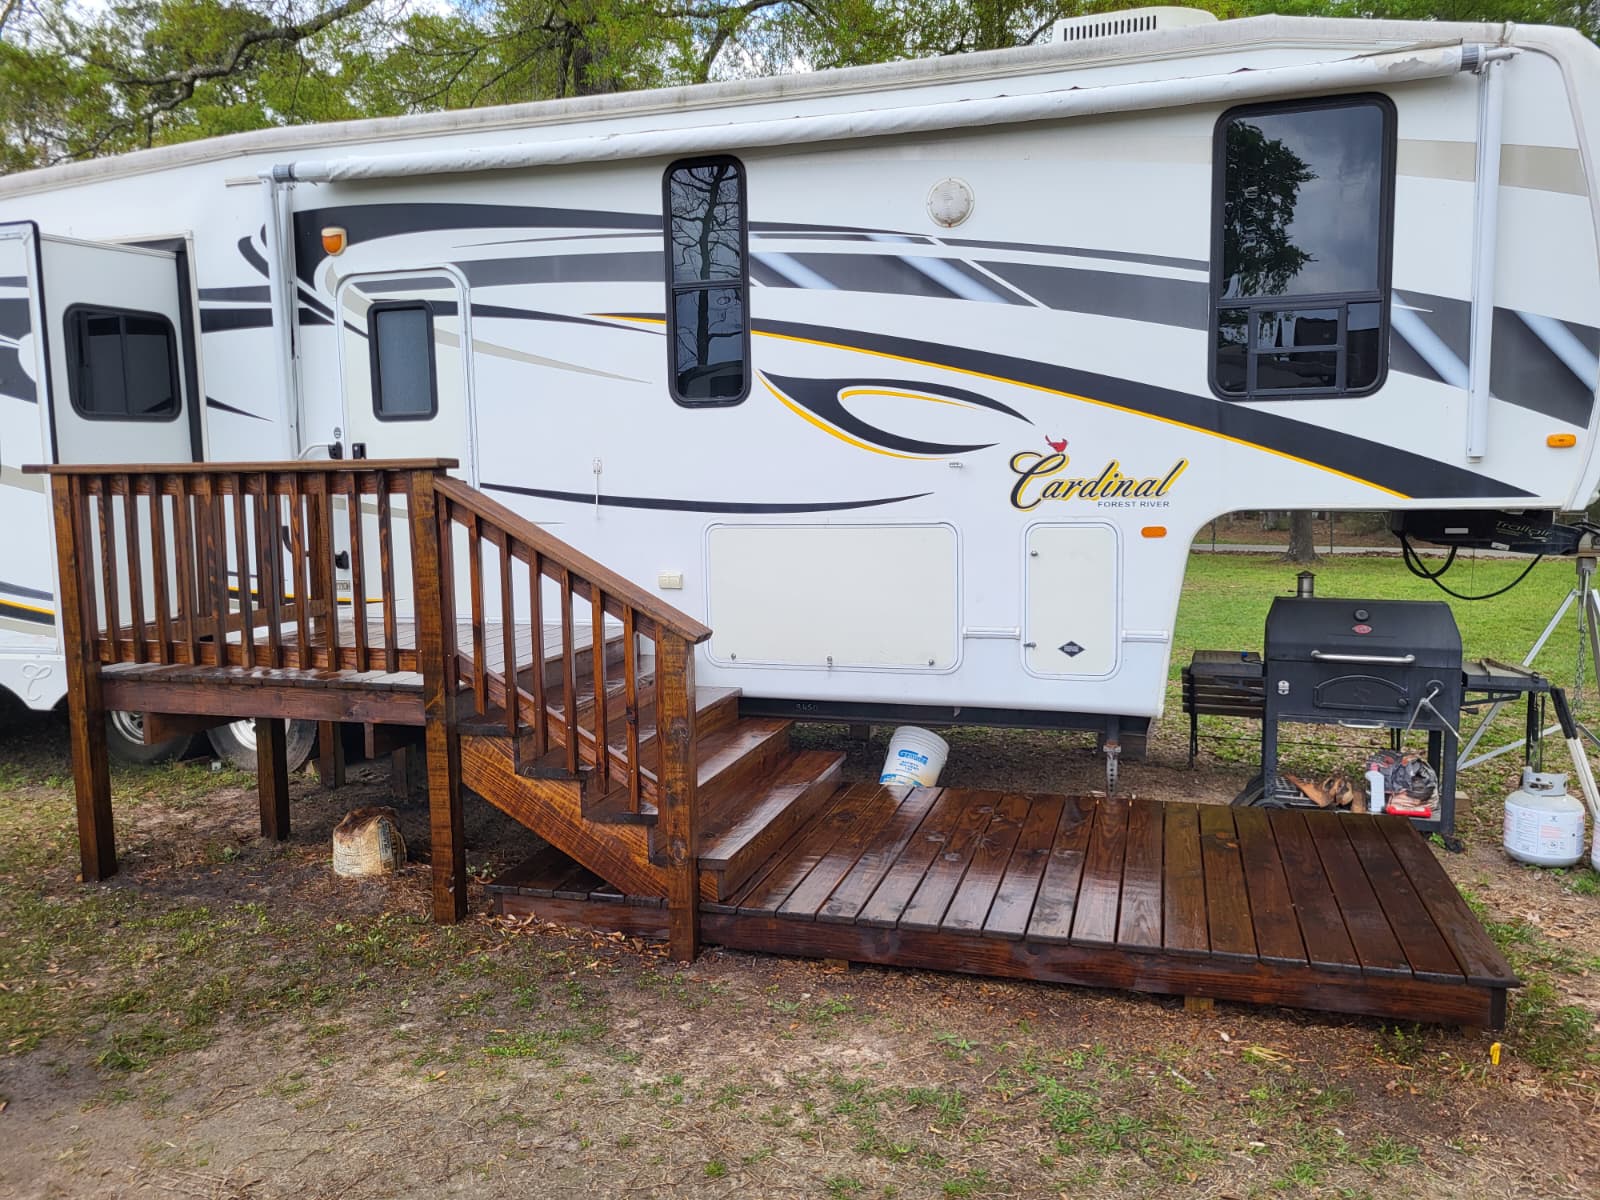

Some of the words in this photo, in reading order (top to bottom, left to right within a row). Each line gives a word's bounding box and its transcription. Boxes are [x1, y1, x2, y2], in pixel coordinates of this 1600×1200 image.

[1009, 451, 1190, 512] Cardinal
[1097, 500, 1136, 508] FOREST
[1139, 500, 1170, 508] RIVER
